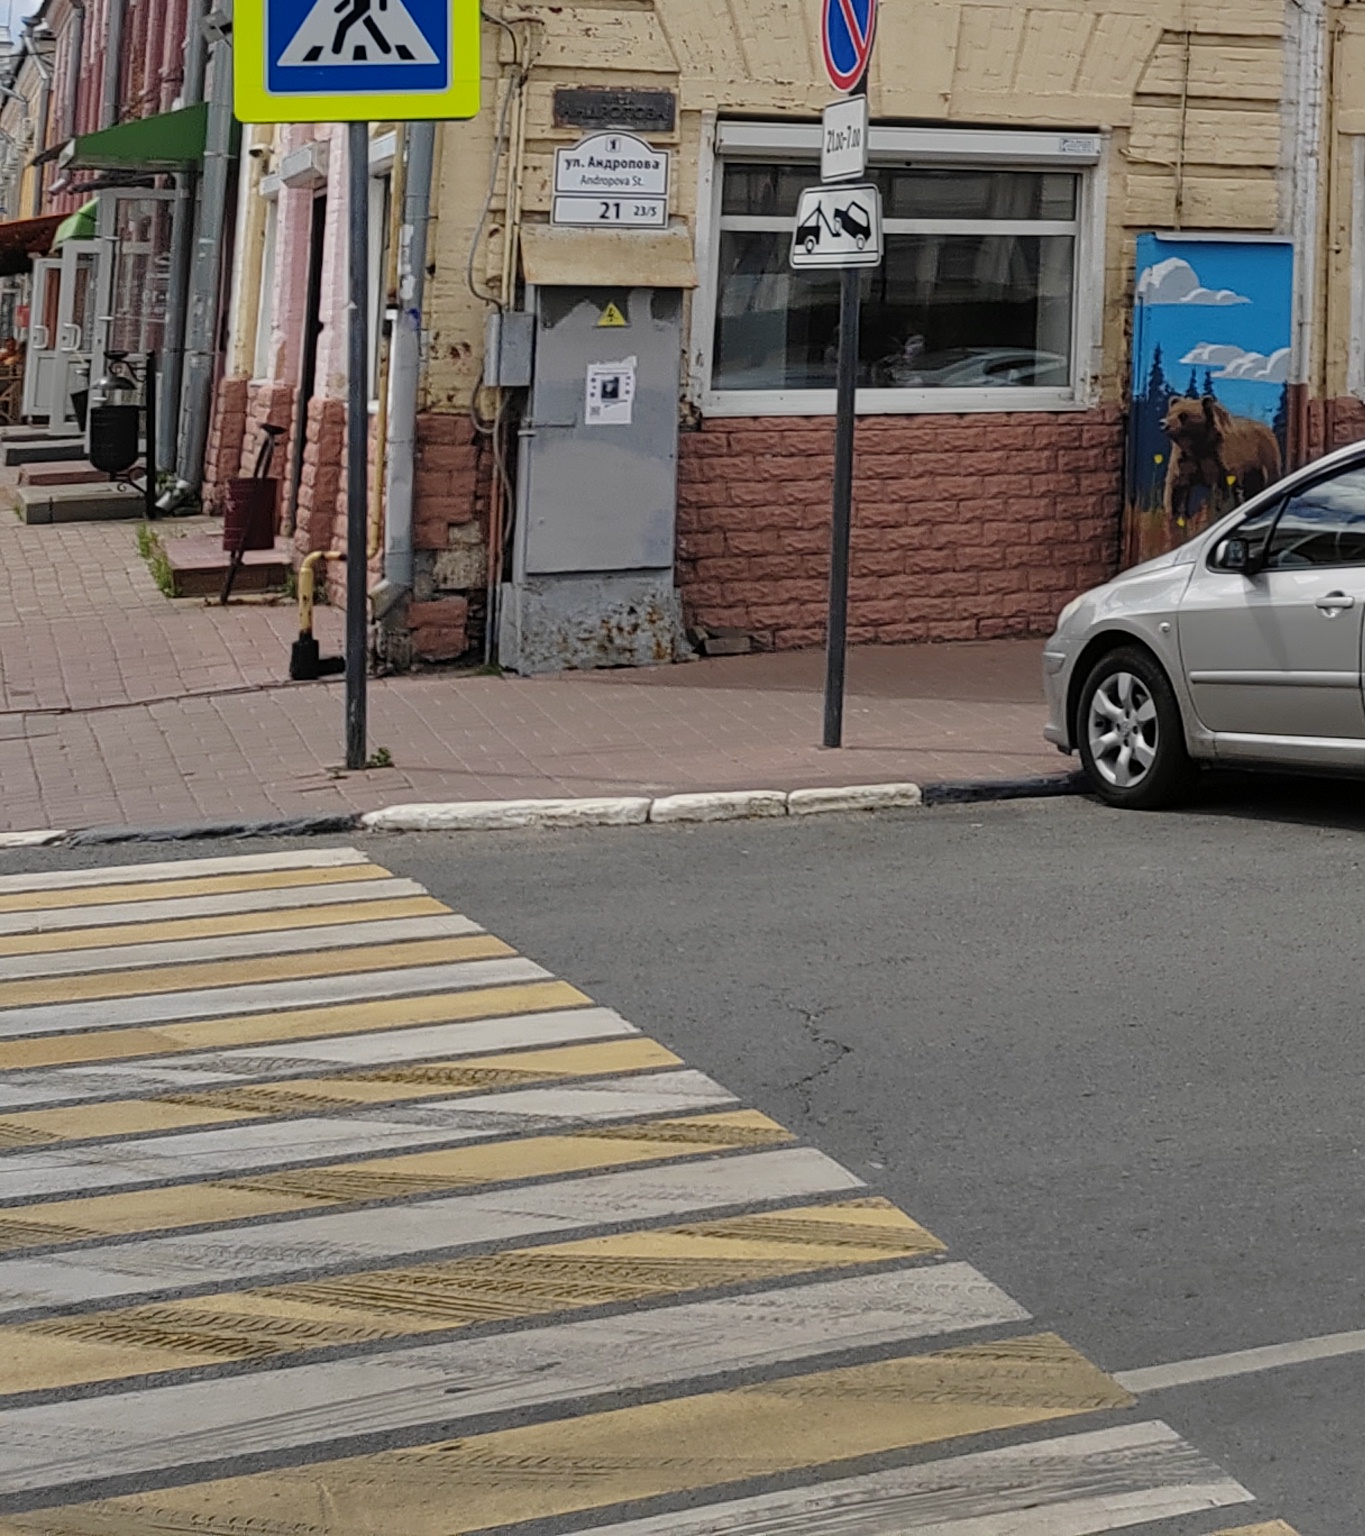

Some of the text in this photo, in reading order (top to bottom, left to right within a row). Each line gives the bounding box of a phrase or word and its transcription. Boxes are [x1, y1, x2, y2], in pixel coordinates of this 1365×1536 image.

[565, 156, 660, 171] ул. Андропова
[581, 175, 630, 187] Andropova
[599, 202, 657, 220] 21 23/5
